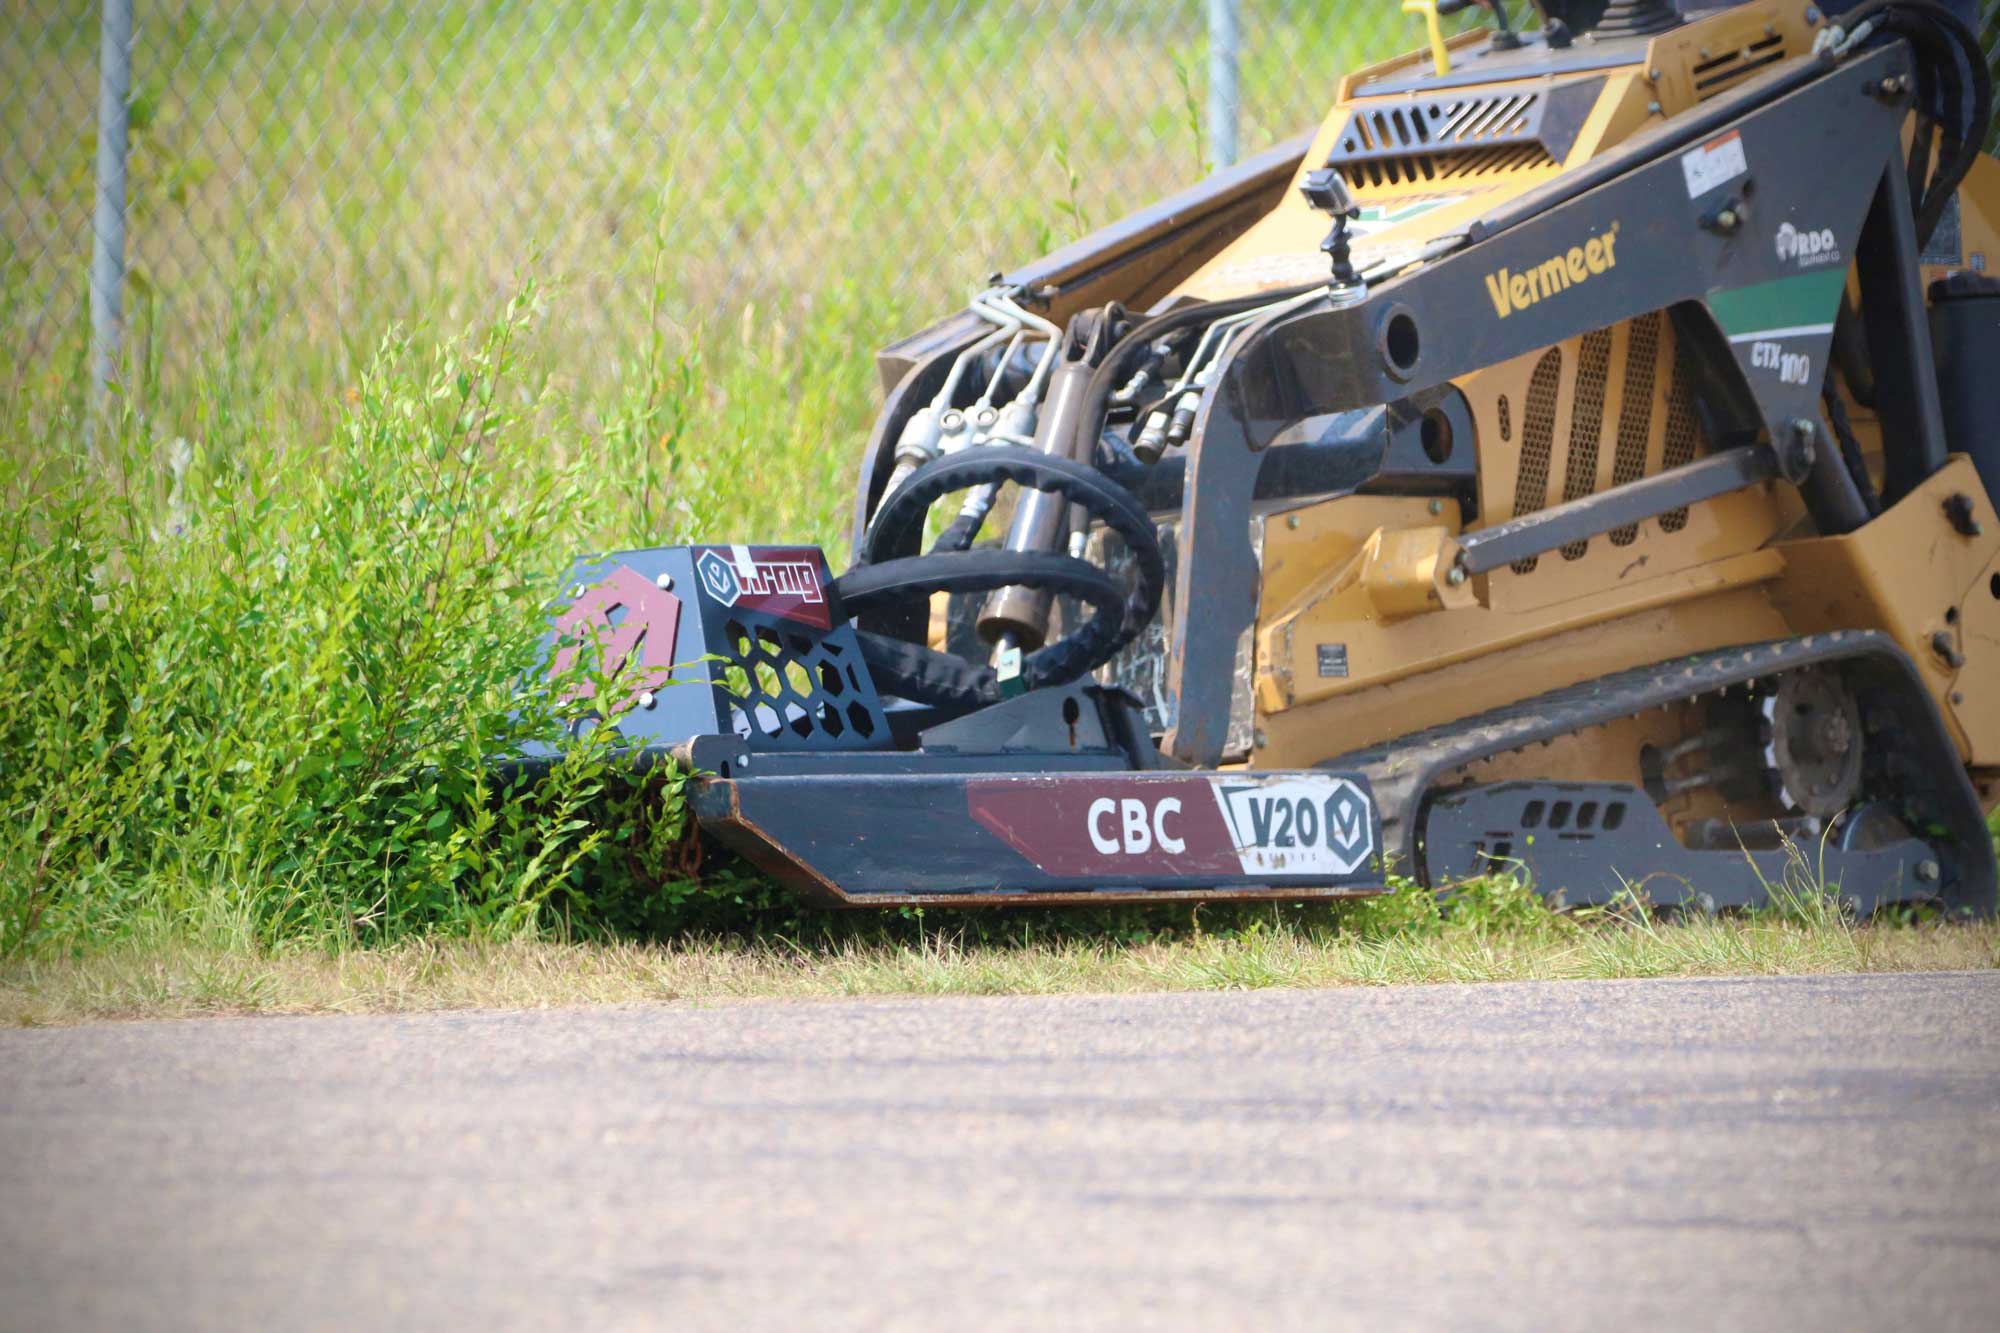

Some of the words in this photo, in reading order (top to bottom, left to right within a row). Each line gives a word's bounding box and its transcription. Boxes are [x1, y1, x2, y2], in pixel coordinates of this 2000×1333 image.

[1798, 228, 1835, 255] RDO
[1485, 231, 1616, 319] Vermeer
[1088, 797, 1186, 855] CBC
[1248, 797, 1318, 847] V20
